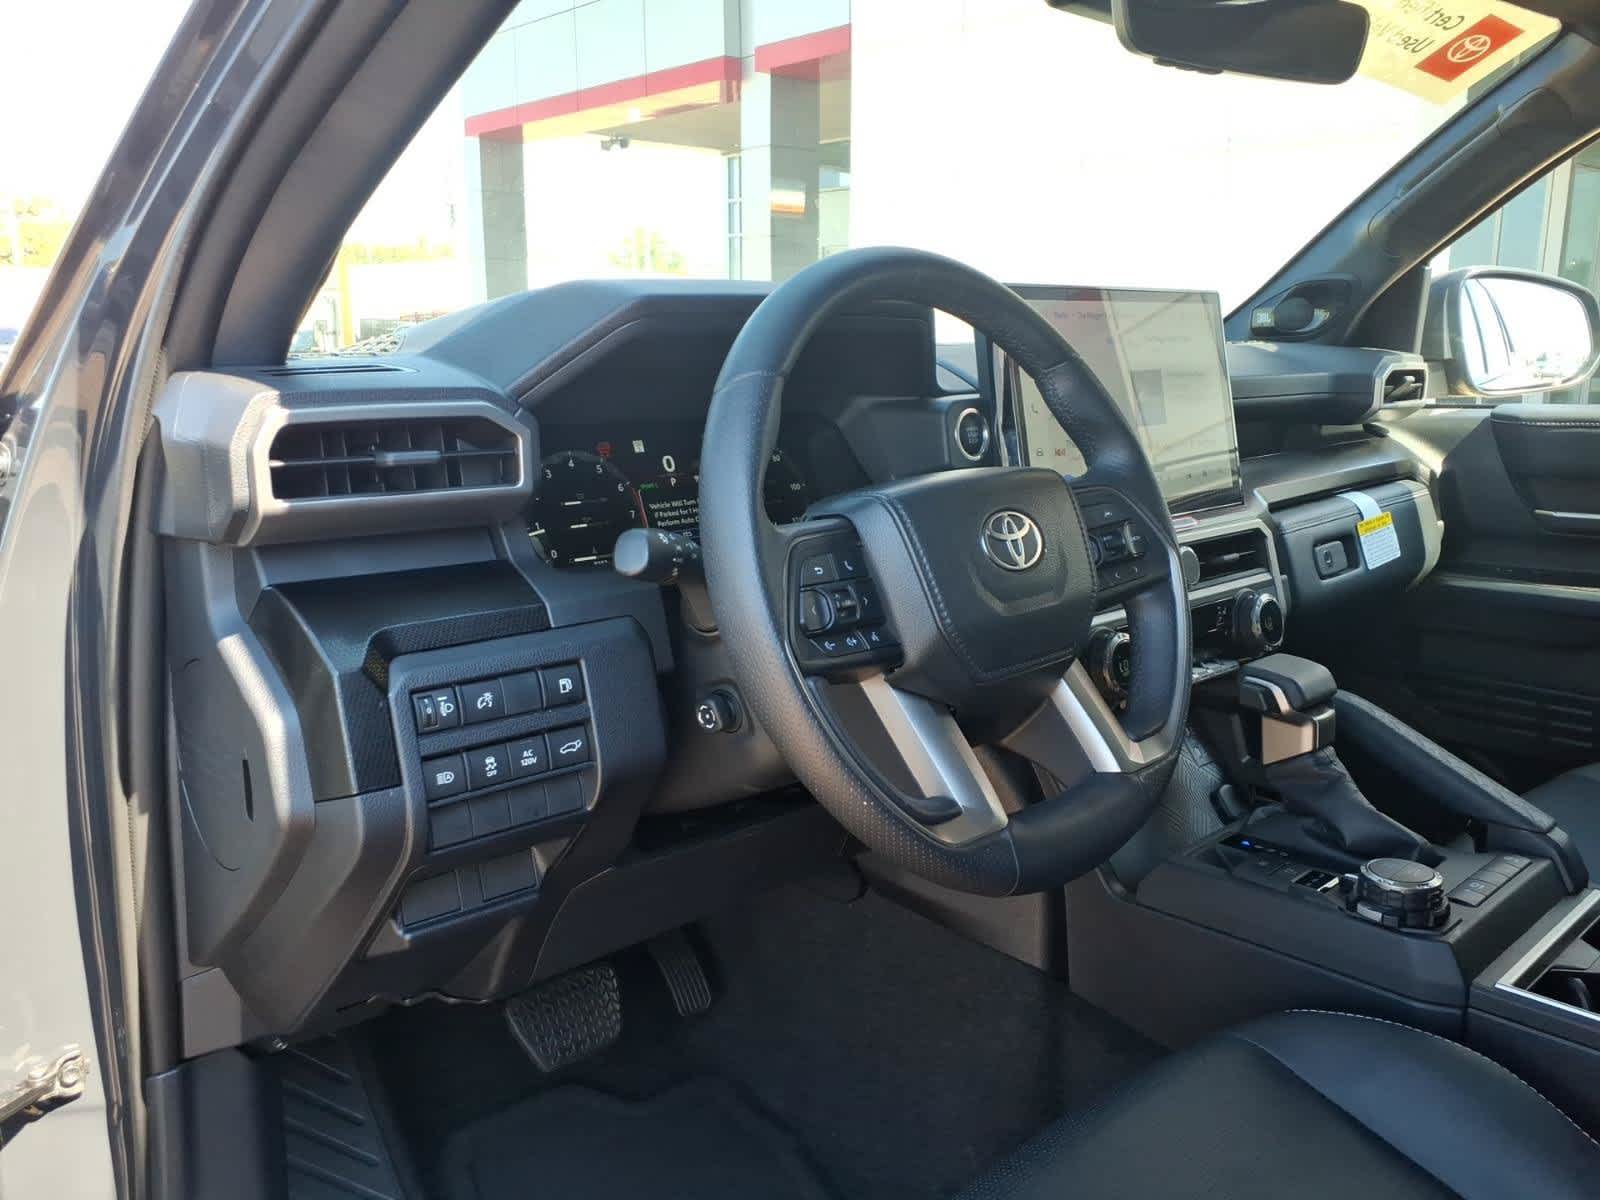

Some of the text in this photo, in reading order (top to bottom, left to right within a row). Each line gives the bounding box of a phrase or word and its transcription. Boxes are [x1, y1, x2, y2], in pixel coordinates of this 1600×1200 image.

[662, 455, 676, 473] 0
[596, 464, 603, 474] 5
[545, 469, 552, 479] 3
[617, 483, 624, 492] 6
[523, 749, 534, 757] AC
[520, 757, 538, 766] 120V
